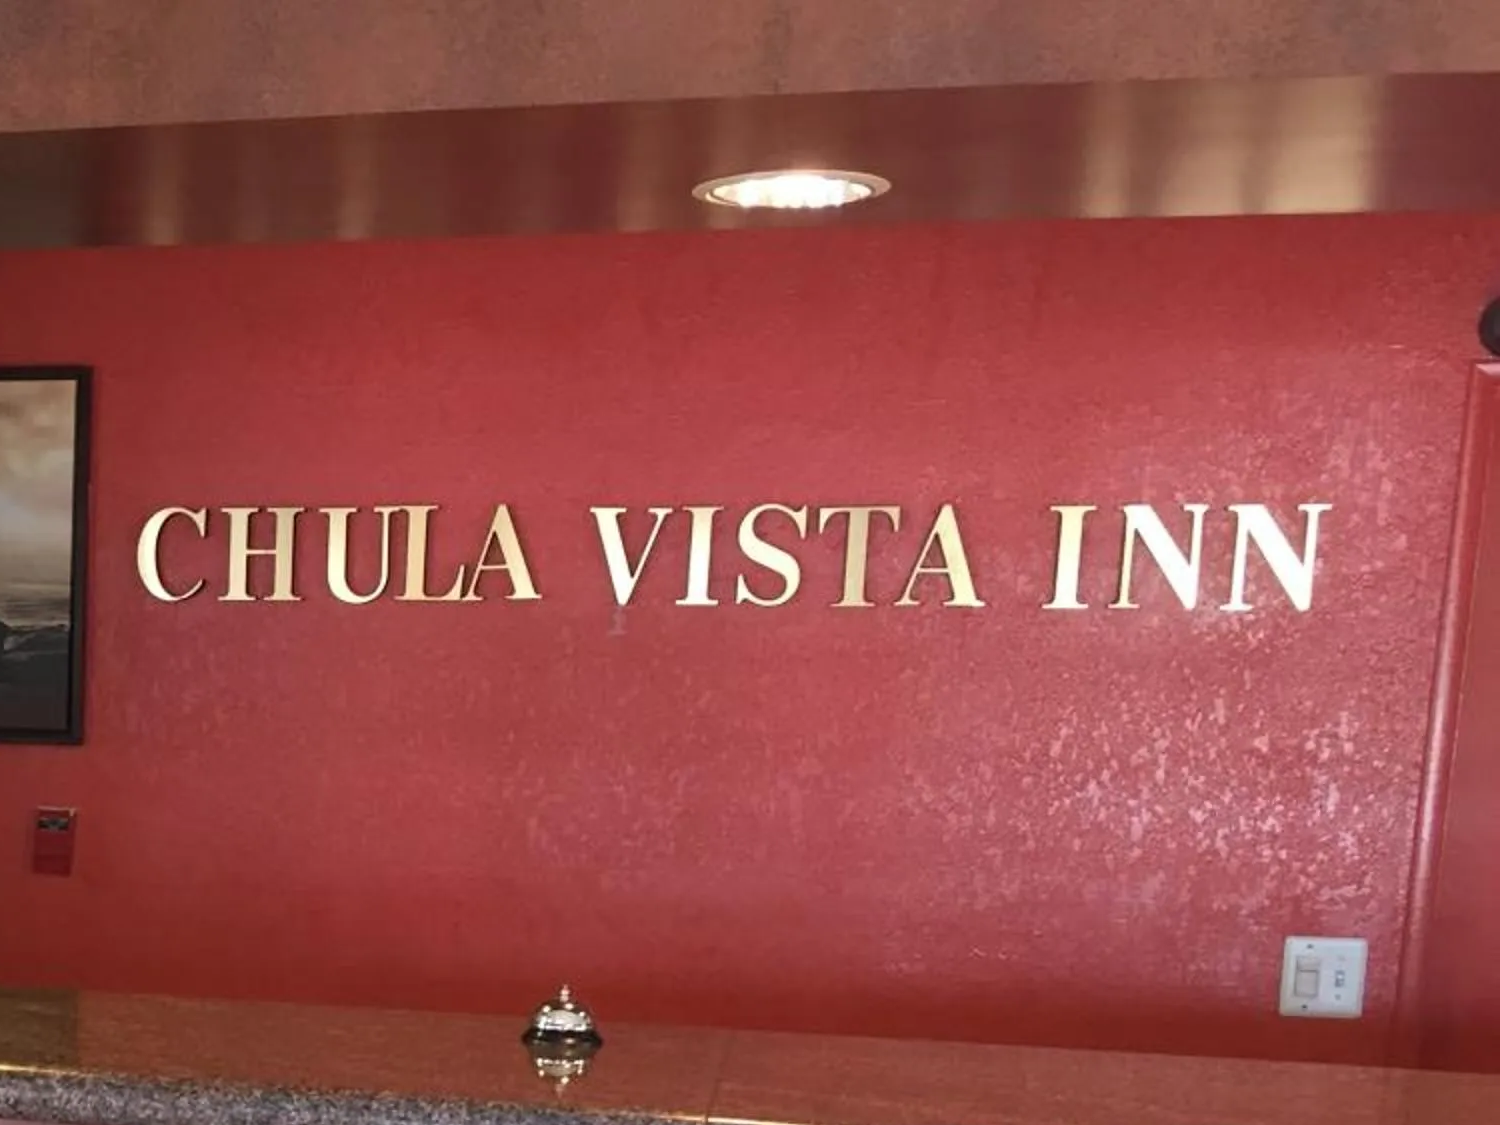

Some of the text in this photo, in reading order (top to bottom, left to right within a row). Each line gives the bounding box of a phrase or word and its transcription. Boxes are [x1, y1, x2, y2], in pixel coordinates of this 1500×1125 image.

[136, 503, 1333, 613] CHULA VISTA INN
